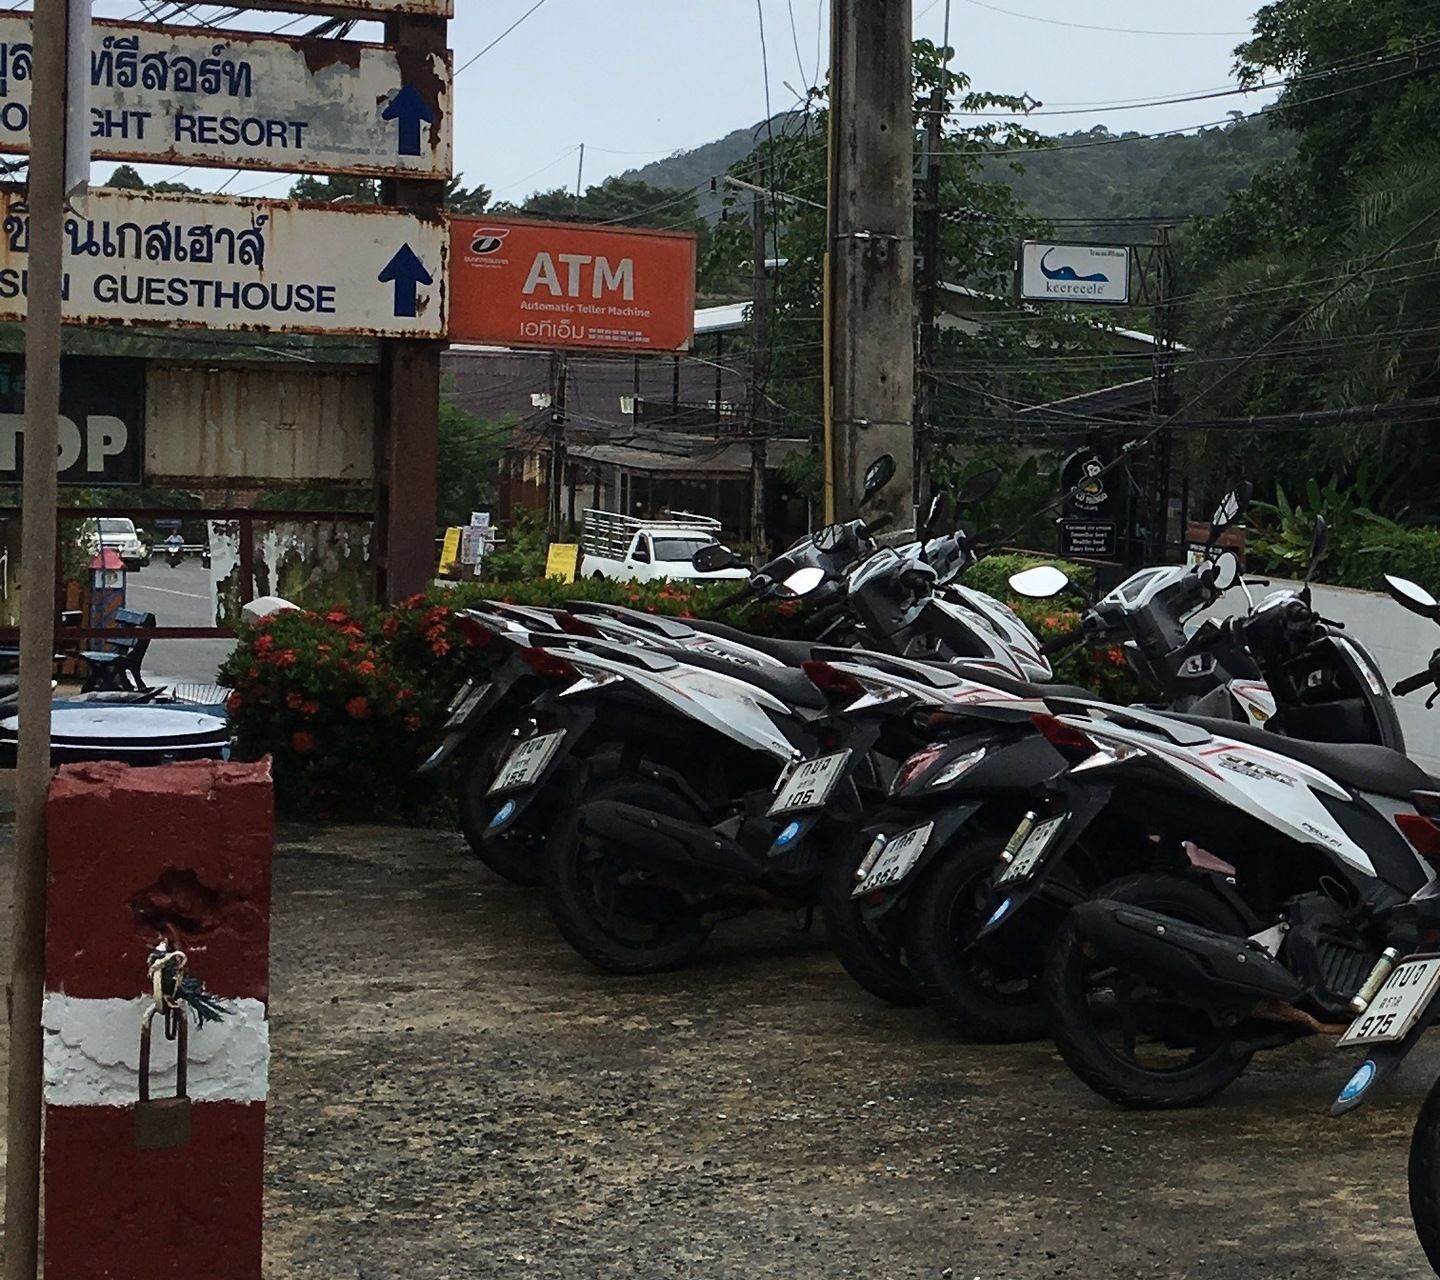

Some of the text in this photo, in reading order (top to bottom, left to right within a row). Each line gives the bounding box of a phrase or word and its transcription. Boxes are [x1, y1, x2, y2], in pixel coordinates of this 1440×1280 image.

[174, 114, 309, 150] RESORT
[522, 251, 635, 301] ATM
[94, 274, 336, 314] GUESTHOUSE
[520, 300, 651, 318] Automatic Teller Machine
[520, 319, 585, 340] เอทีเอ็ม
[784, 789, 814, 808] 106
[862, 865, 900, 891] 3362
[1356, 1013, 1397, 1038] 975
